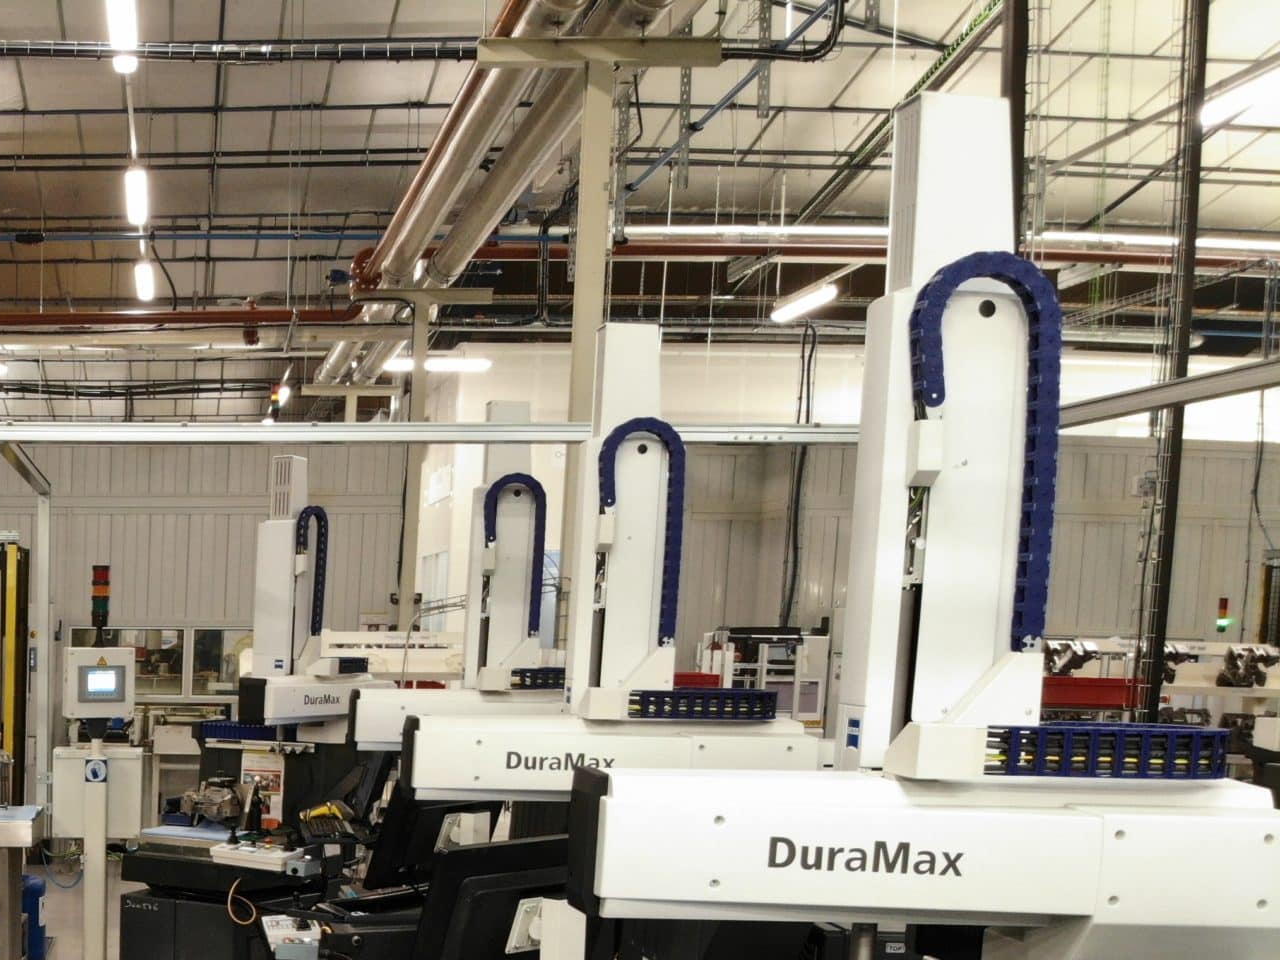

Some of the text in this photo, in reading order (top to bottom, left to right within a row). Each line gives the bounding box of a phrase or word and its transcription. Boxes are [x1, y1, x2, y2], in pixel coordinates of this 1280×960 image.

[303, 694, 340, 706] DuraMax
[506, 751, 615, 771] DuraMax
[768, 836, 964, 877] DuraMax
